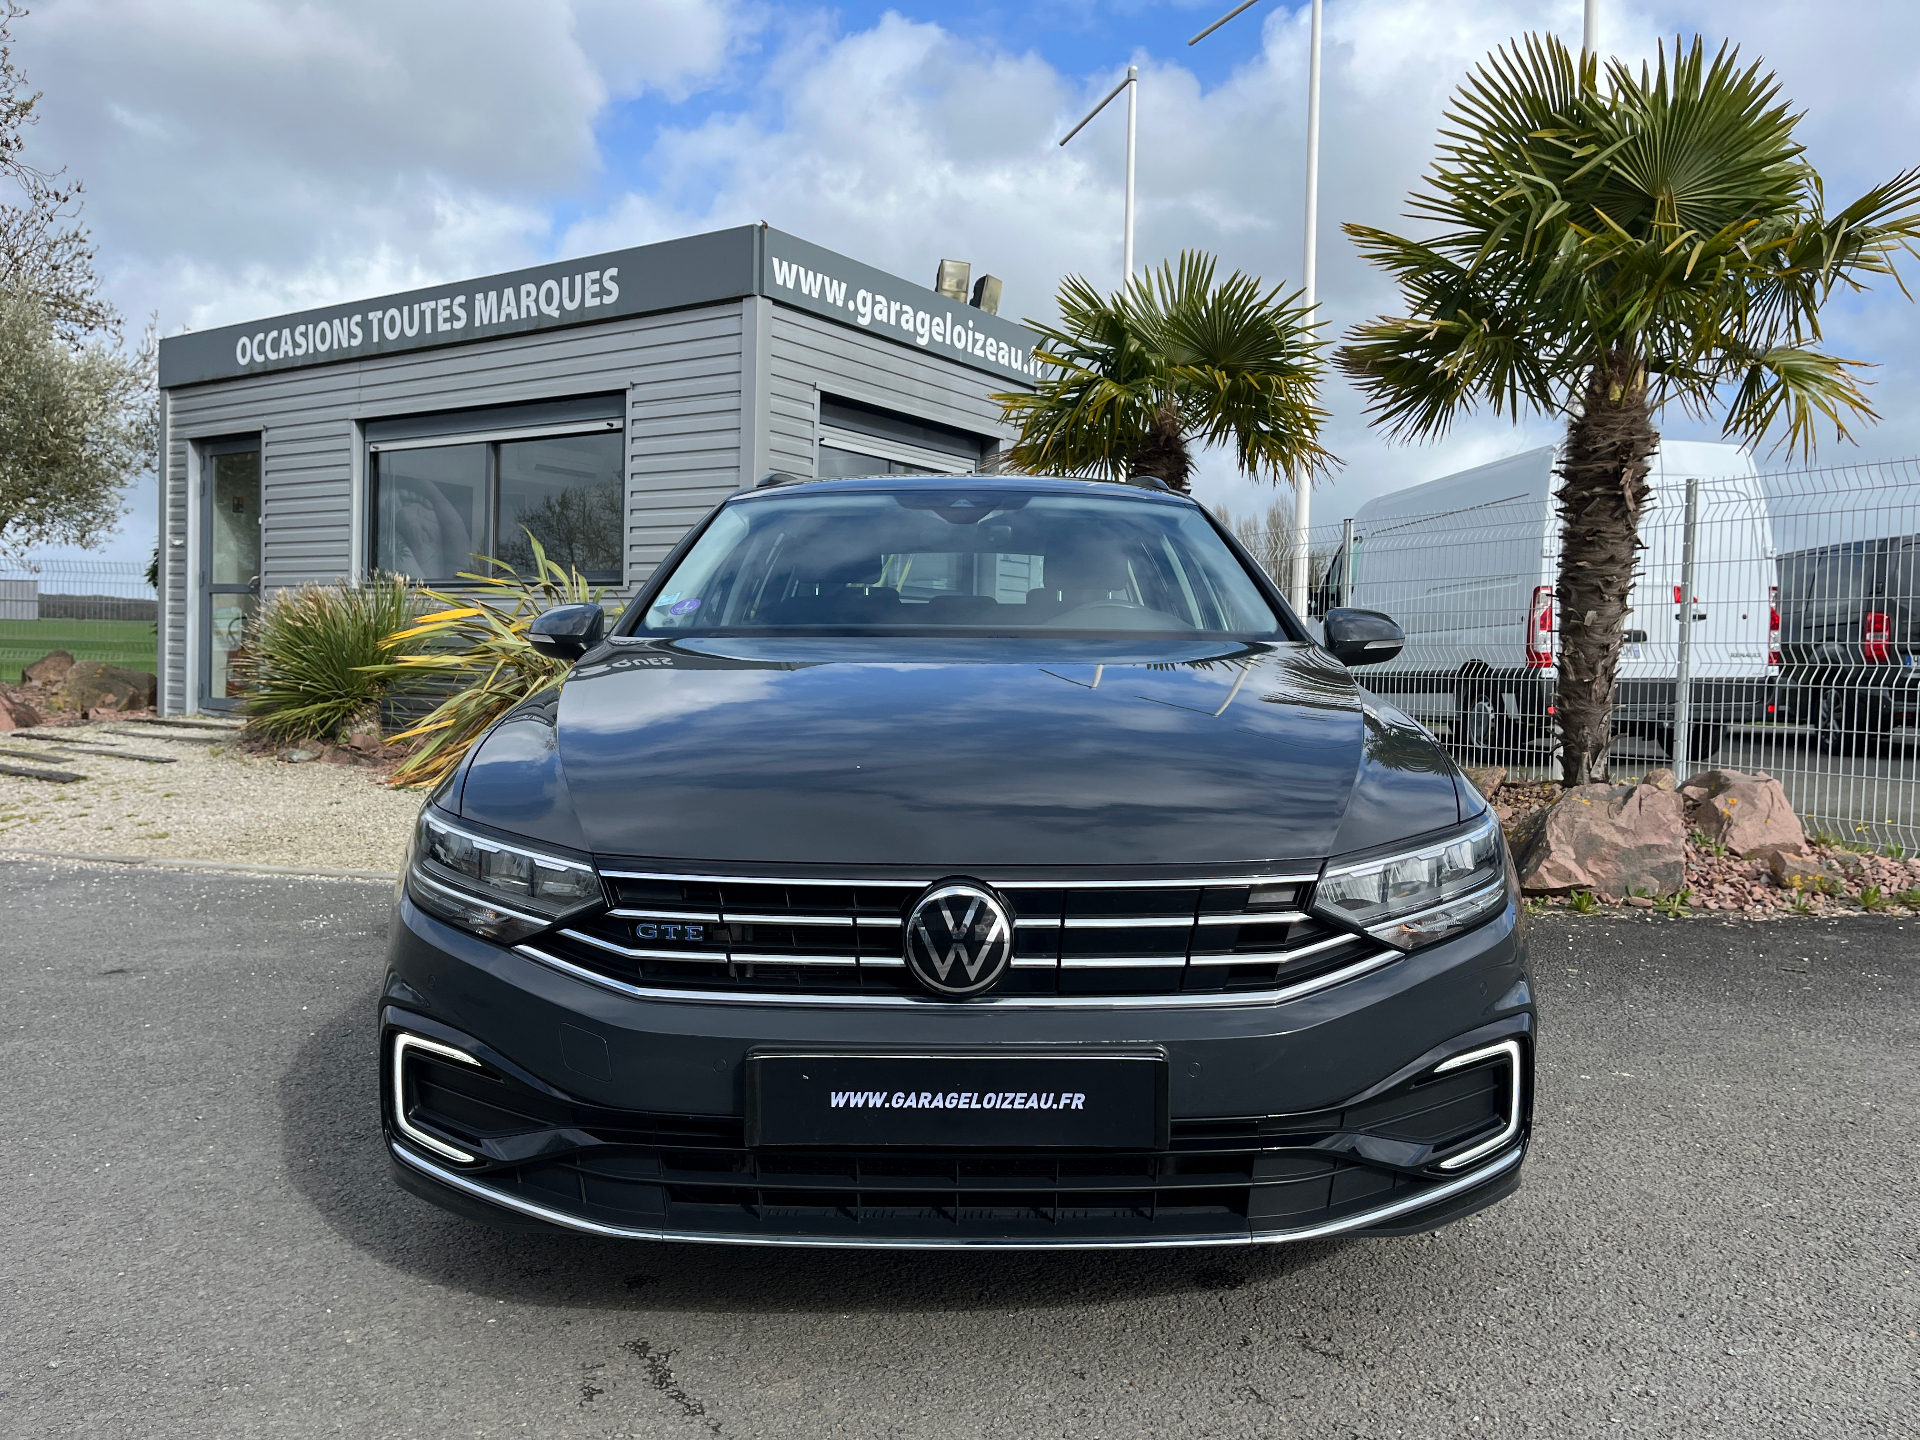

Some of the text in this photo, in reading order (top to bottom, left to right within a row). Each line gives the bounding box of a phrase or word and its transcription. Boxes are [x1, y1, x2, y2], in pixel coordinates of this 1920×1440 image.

[236, 267, 621, 366] OCCASIONS TOUTES MARQUES
[636, 923, 703, 941] GTE
[911, 895, 1003, 982] VW
[830, 1091, 1086, 1110] WWW.GARAGELOIZEAU.FR
